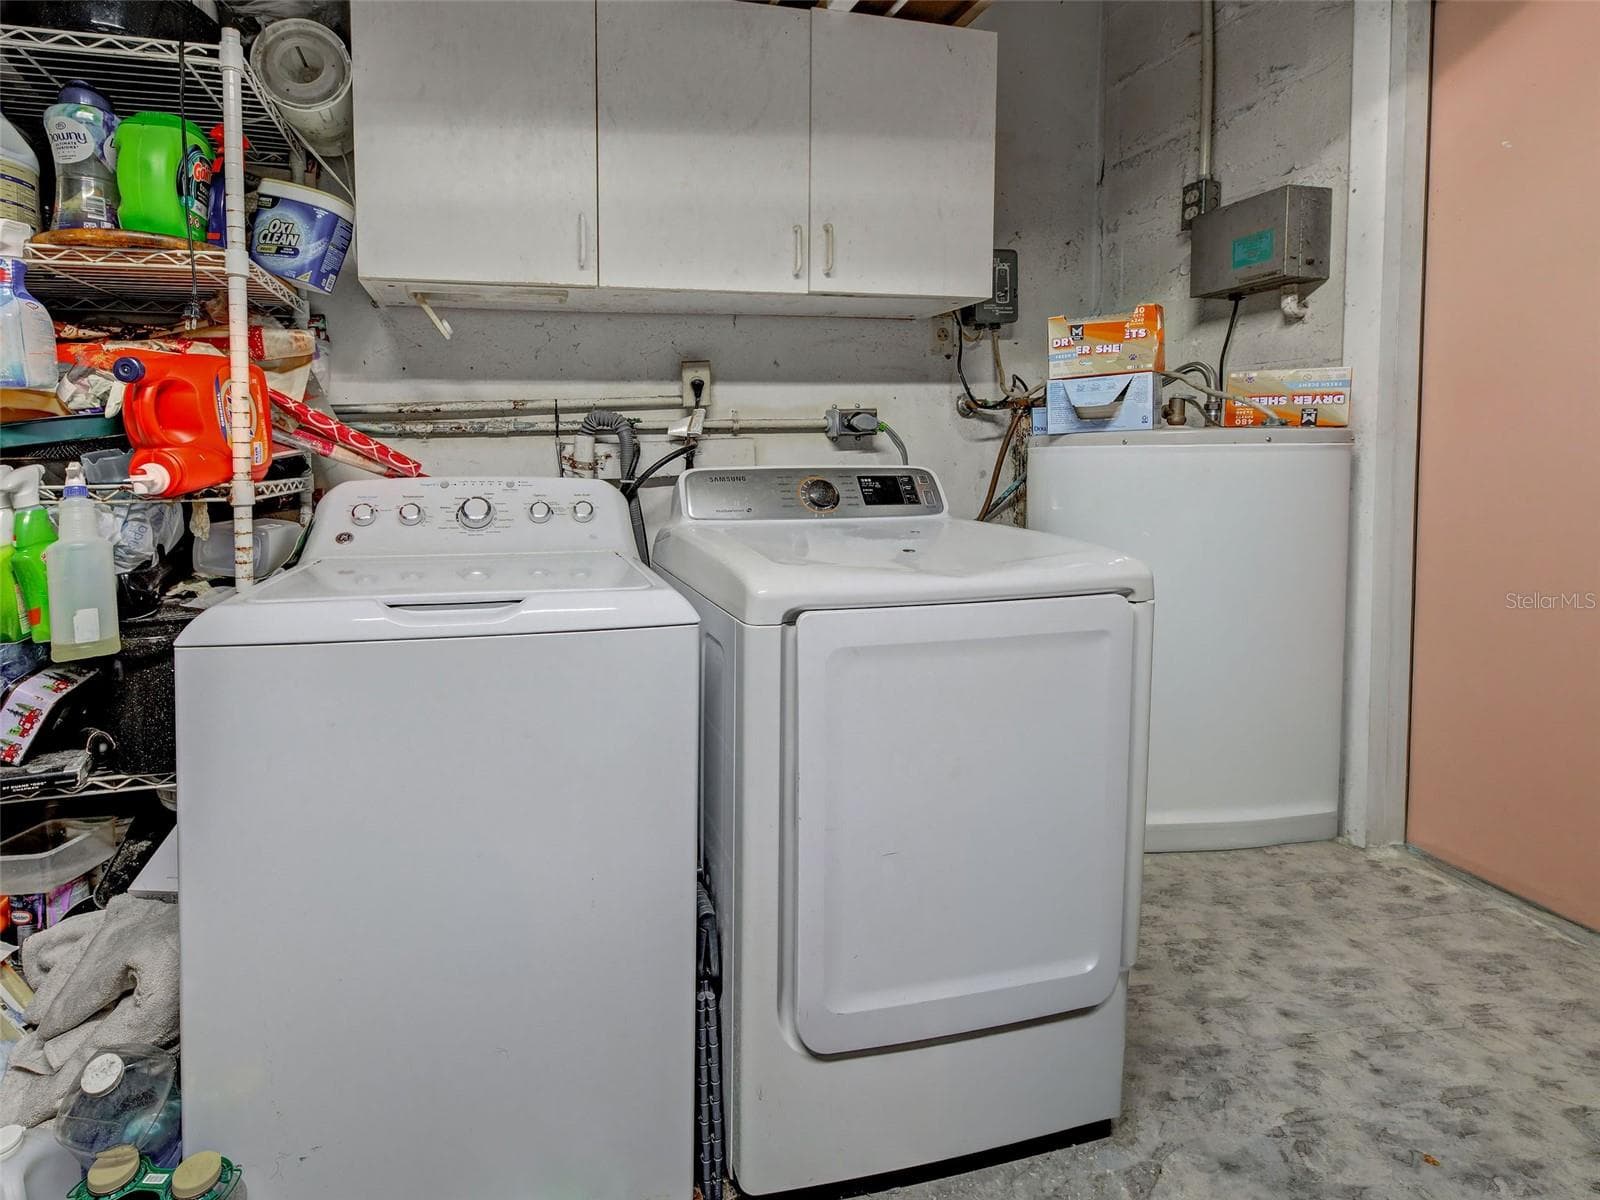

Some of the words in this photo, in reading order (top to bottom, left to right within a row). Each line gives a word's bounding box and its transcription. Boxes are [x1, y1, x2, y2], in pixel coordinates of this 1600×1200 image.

[269, 219, 293, 234] OXI
[259, 230, 299, 246] CLEAN
[1293, 394, 1345, 405] DRYER
[709, 475, 747, 483] SAMSUNG
